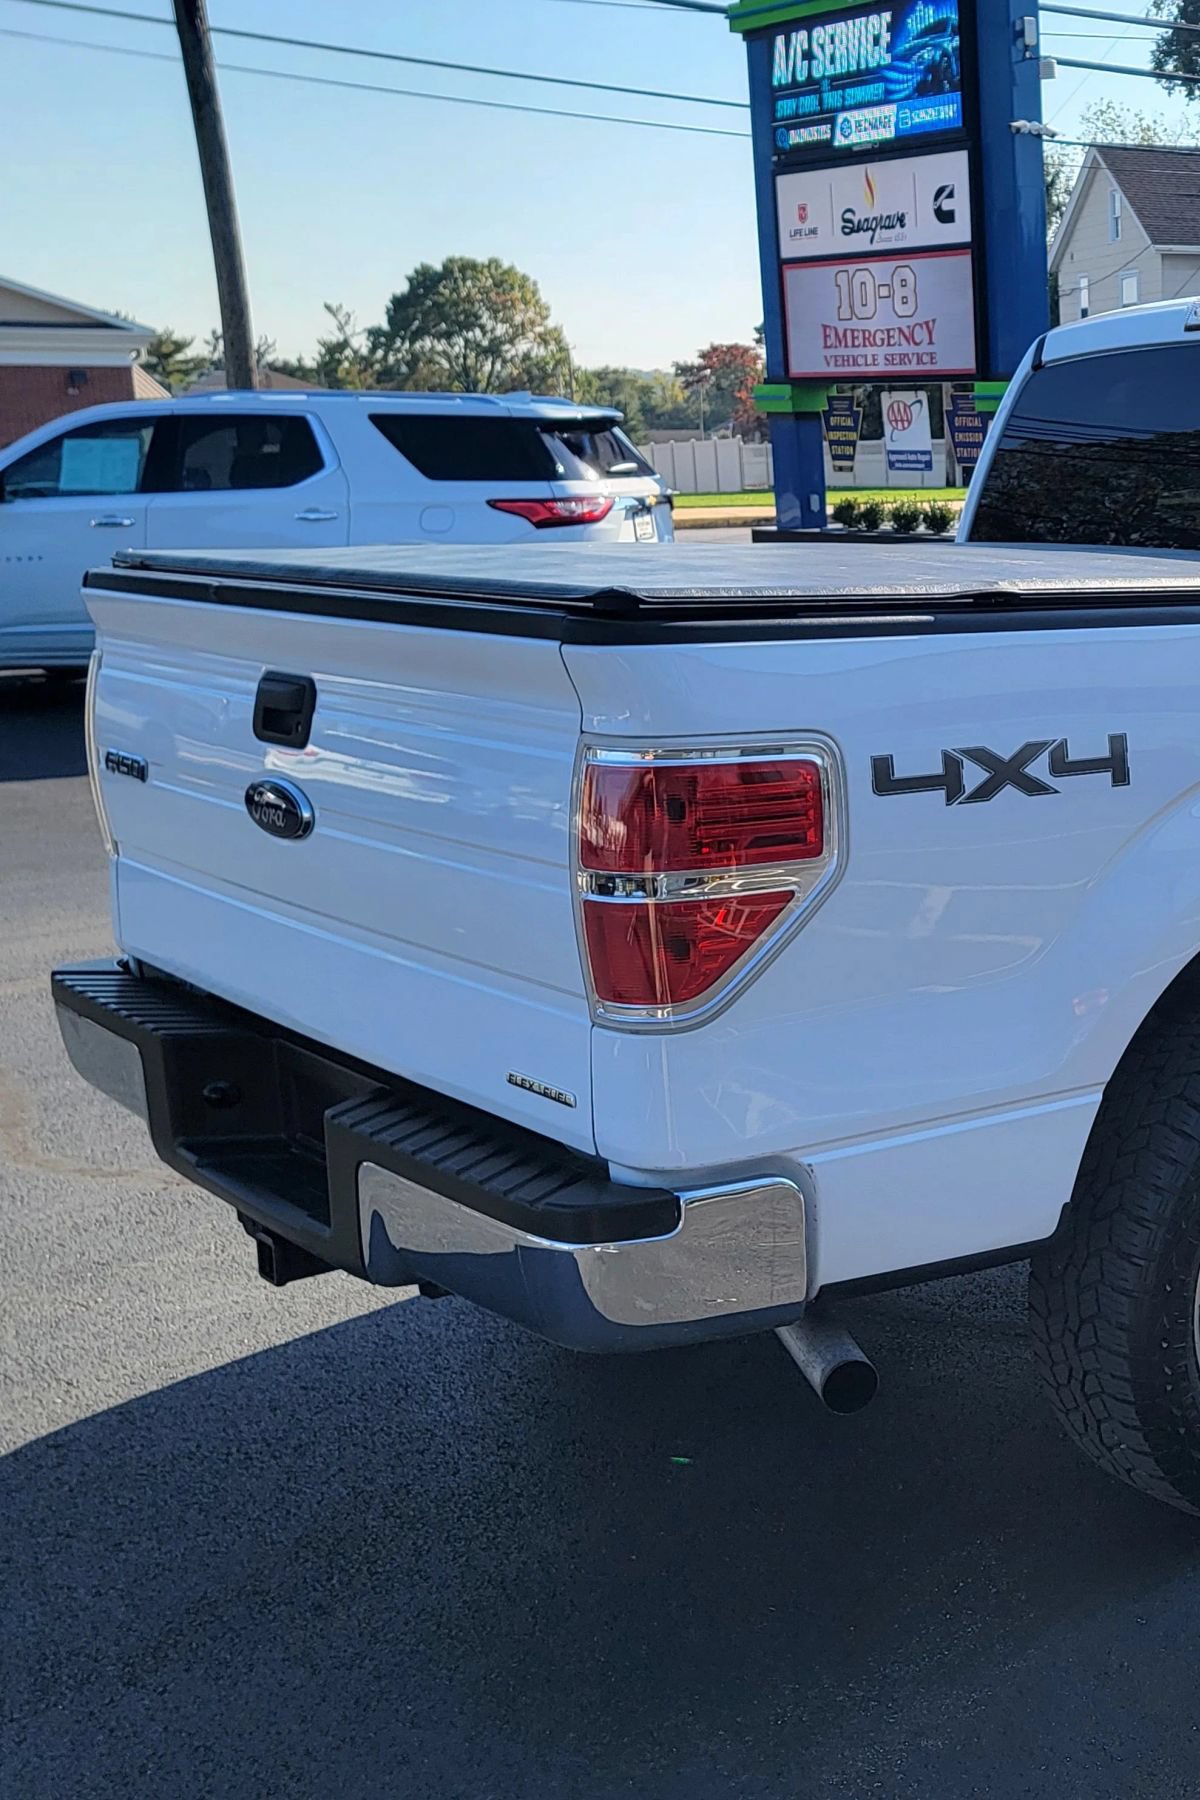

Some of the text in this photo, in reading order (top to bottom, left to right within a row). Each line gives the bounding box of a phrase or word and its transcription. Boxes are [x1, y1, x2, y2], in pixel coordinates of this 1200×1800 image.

[772, 11, 892, 86] A/C SERVICE
[789, 226, 818, 238] LIFE LINE
[841, 208, 906, 245] Seagrave
[835, 265, 918, 321] 10-8
[821, 318, 937, 349] EMERGENCY
[824, 351, 938, 368] VEHICLE SERVICE
[830, 416, 854, 427] OFFICIAL
[954, 416, 982, 427] OFFICIAL
[954, 432, 983, 442] EMISSION
[831, 445, 854, 456] STATION
